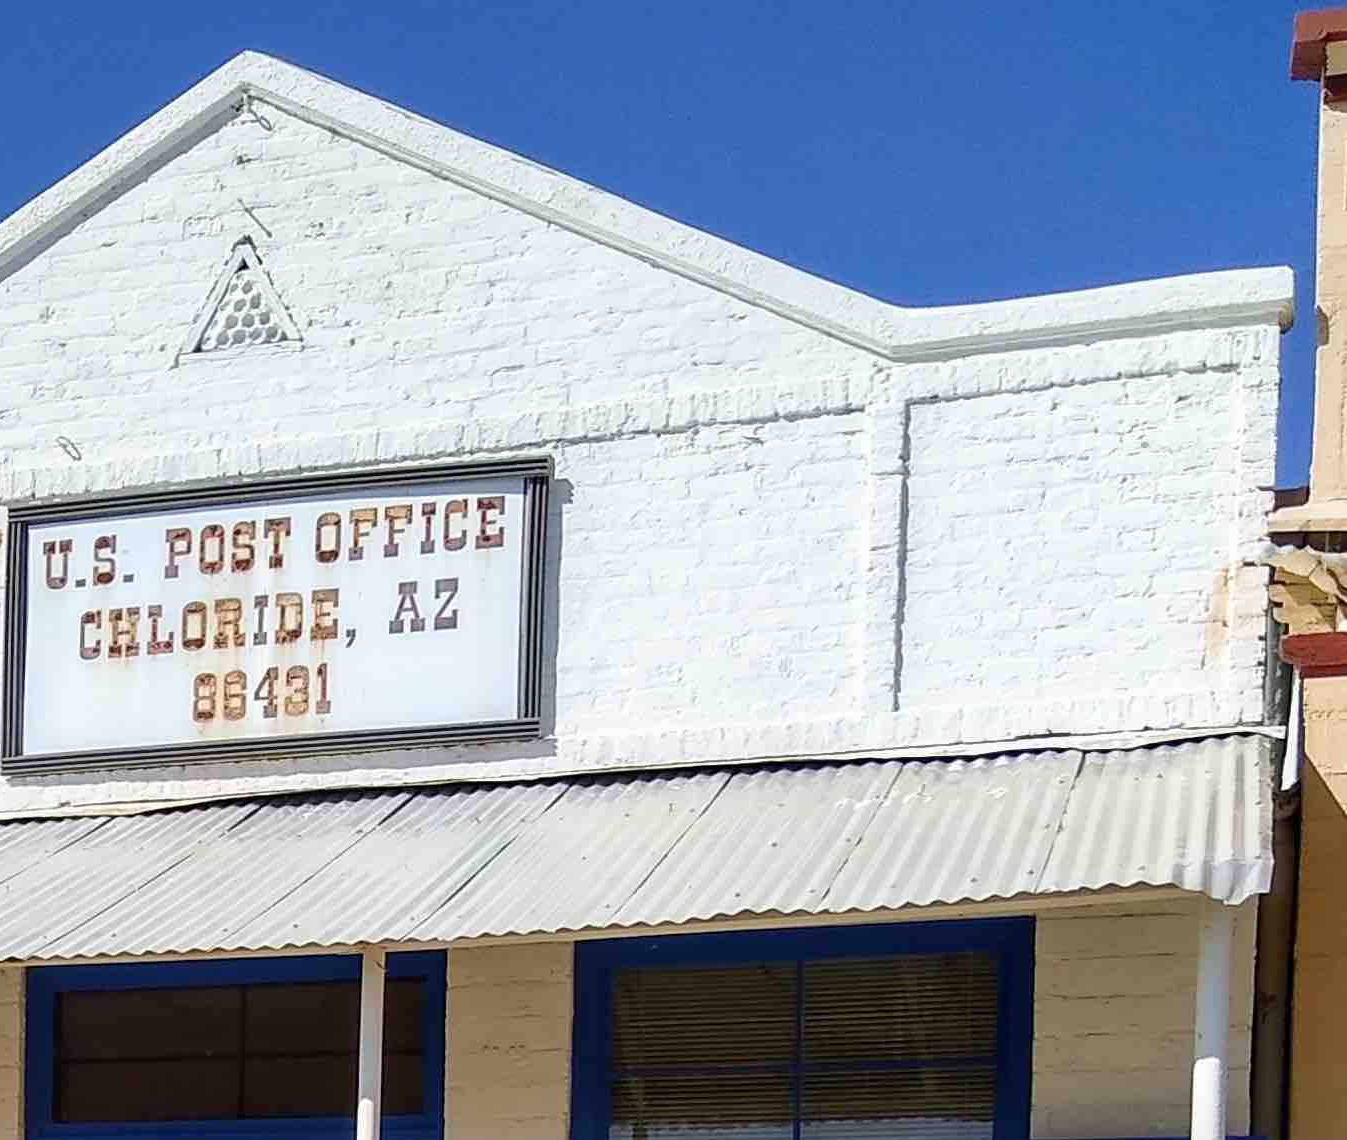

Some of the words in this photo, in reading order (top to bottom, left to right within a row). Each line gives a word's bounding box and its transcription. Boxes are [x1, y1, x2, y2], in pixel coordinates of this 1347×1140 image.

[43, 533, 135, 590] U.S.
[164, 516, 291, 579] POST
[315, 495, 506, 564] OFFICE
[79, 588, 357, 660] CHLORIDE,
[388, 576, 459, 635] AZ
[193, 663, 332, 722] 86431
